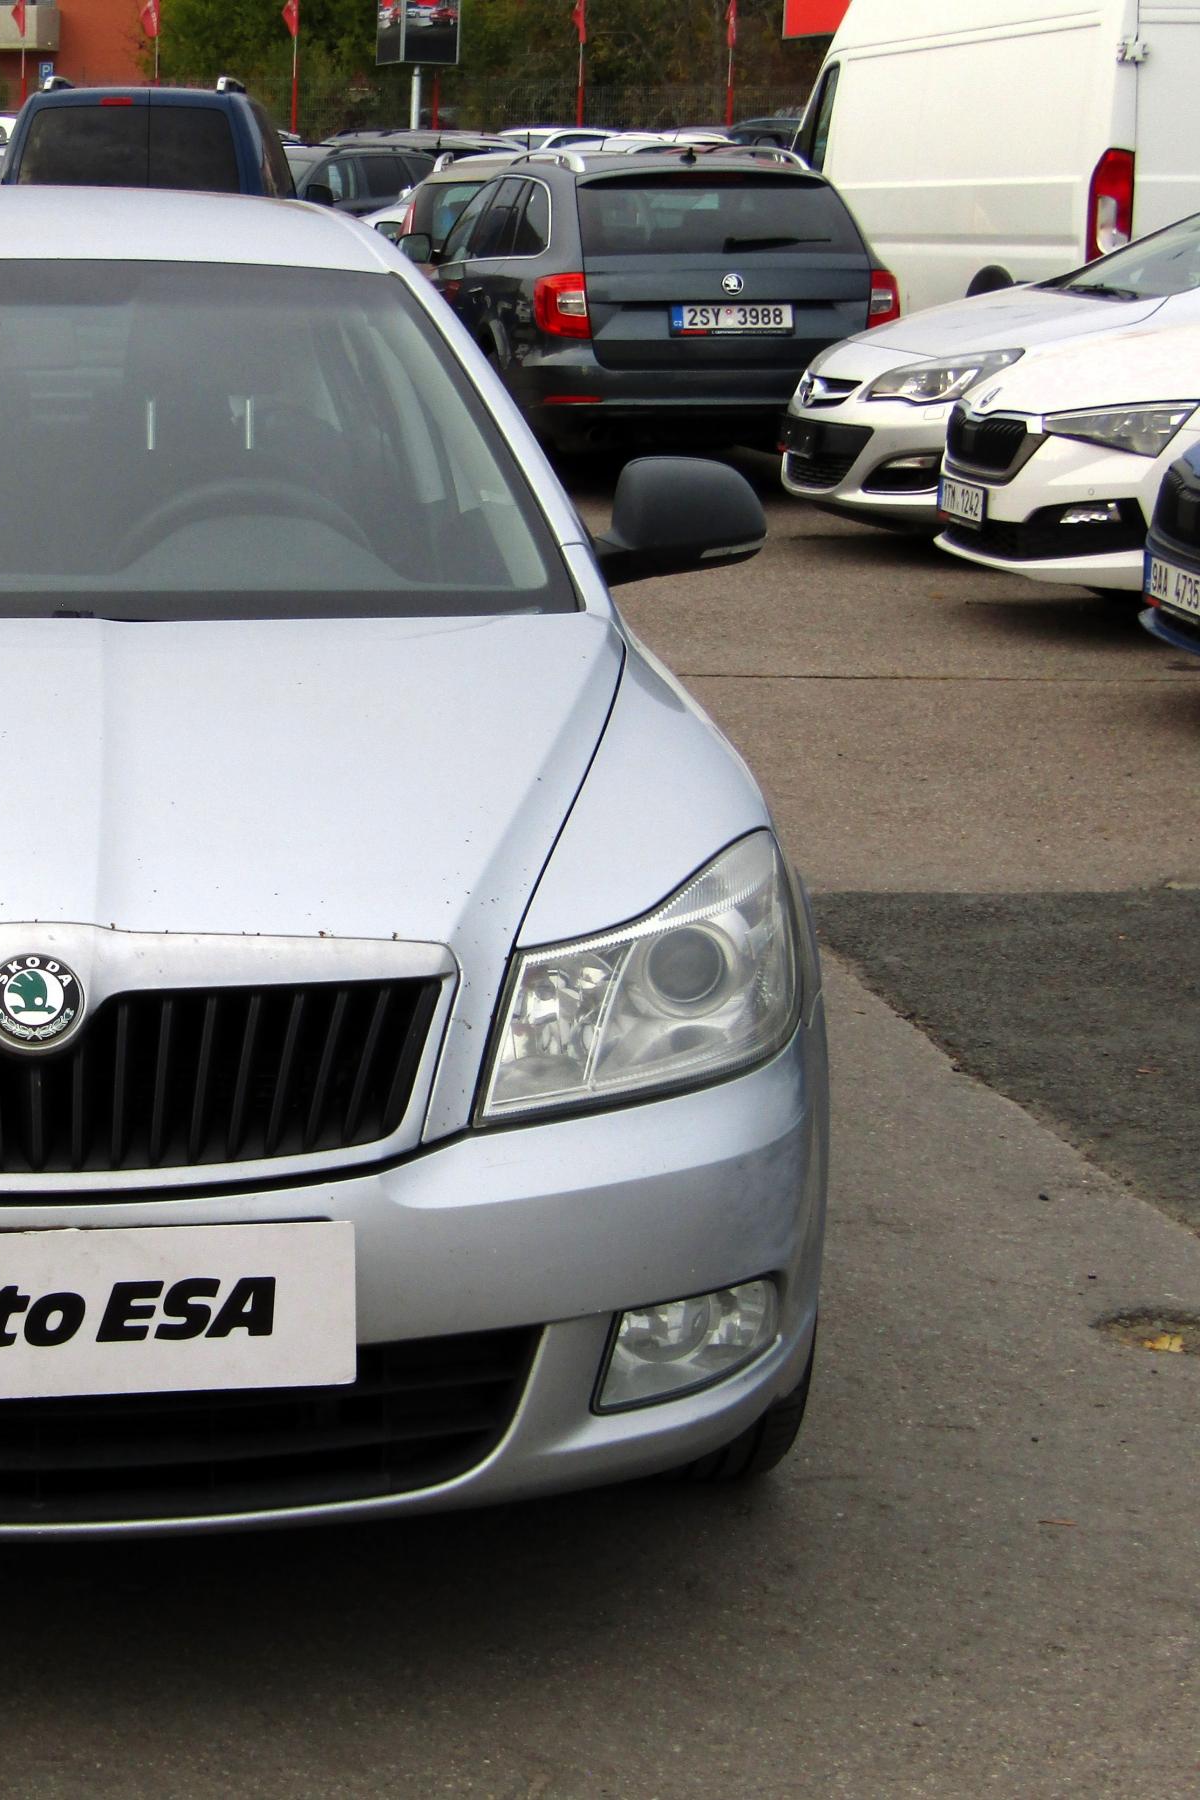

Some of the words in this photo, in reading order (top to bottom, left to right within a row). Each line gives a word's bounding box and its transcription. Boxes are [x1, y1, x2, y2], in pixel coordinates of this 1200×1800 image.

[42, 64, 51, 77] P
[687, 307, 721, 326] 2SY
[737, 307, 783, 326] 3988
[961, 489, 980, 516] 1242
[1152, 563, 1168, 596] 9AA
[1175, 573, 1200, 609] 4735
[96, 1276, 277, 1342] ESA
